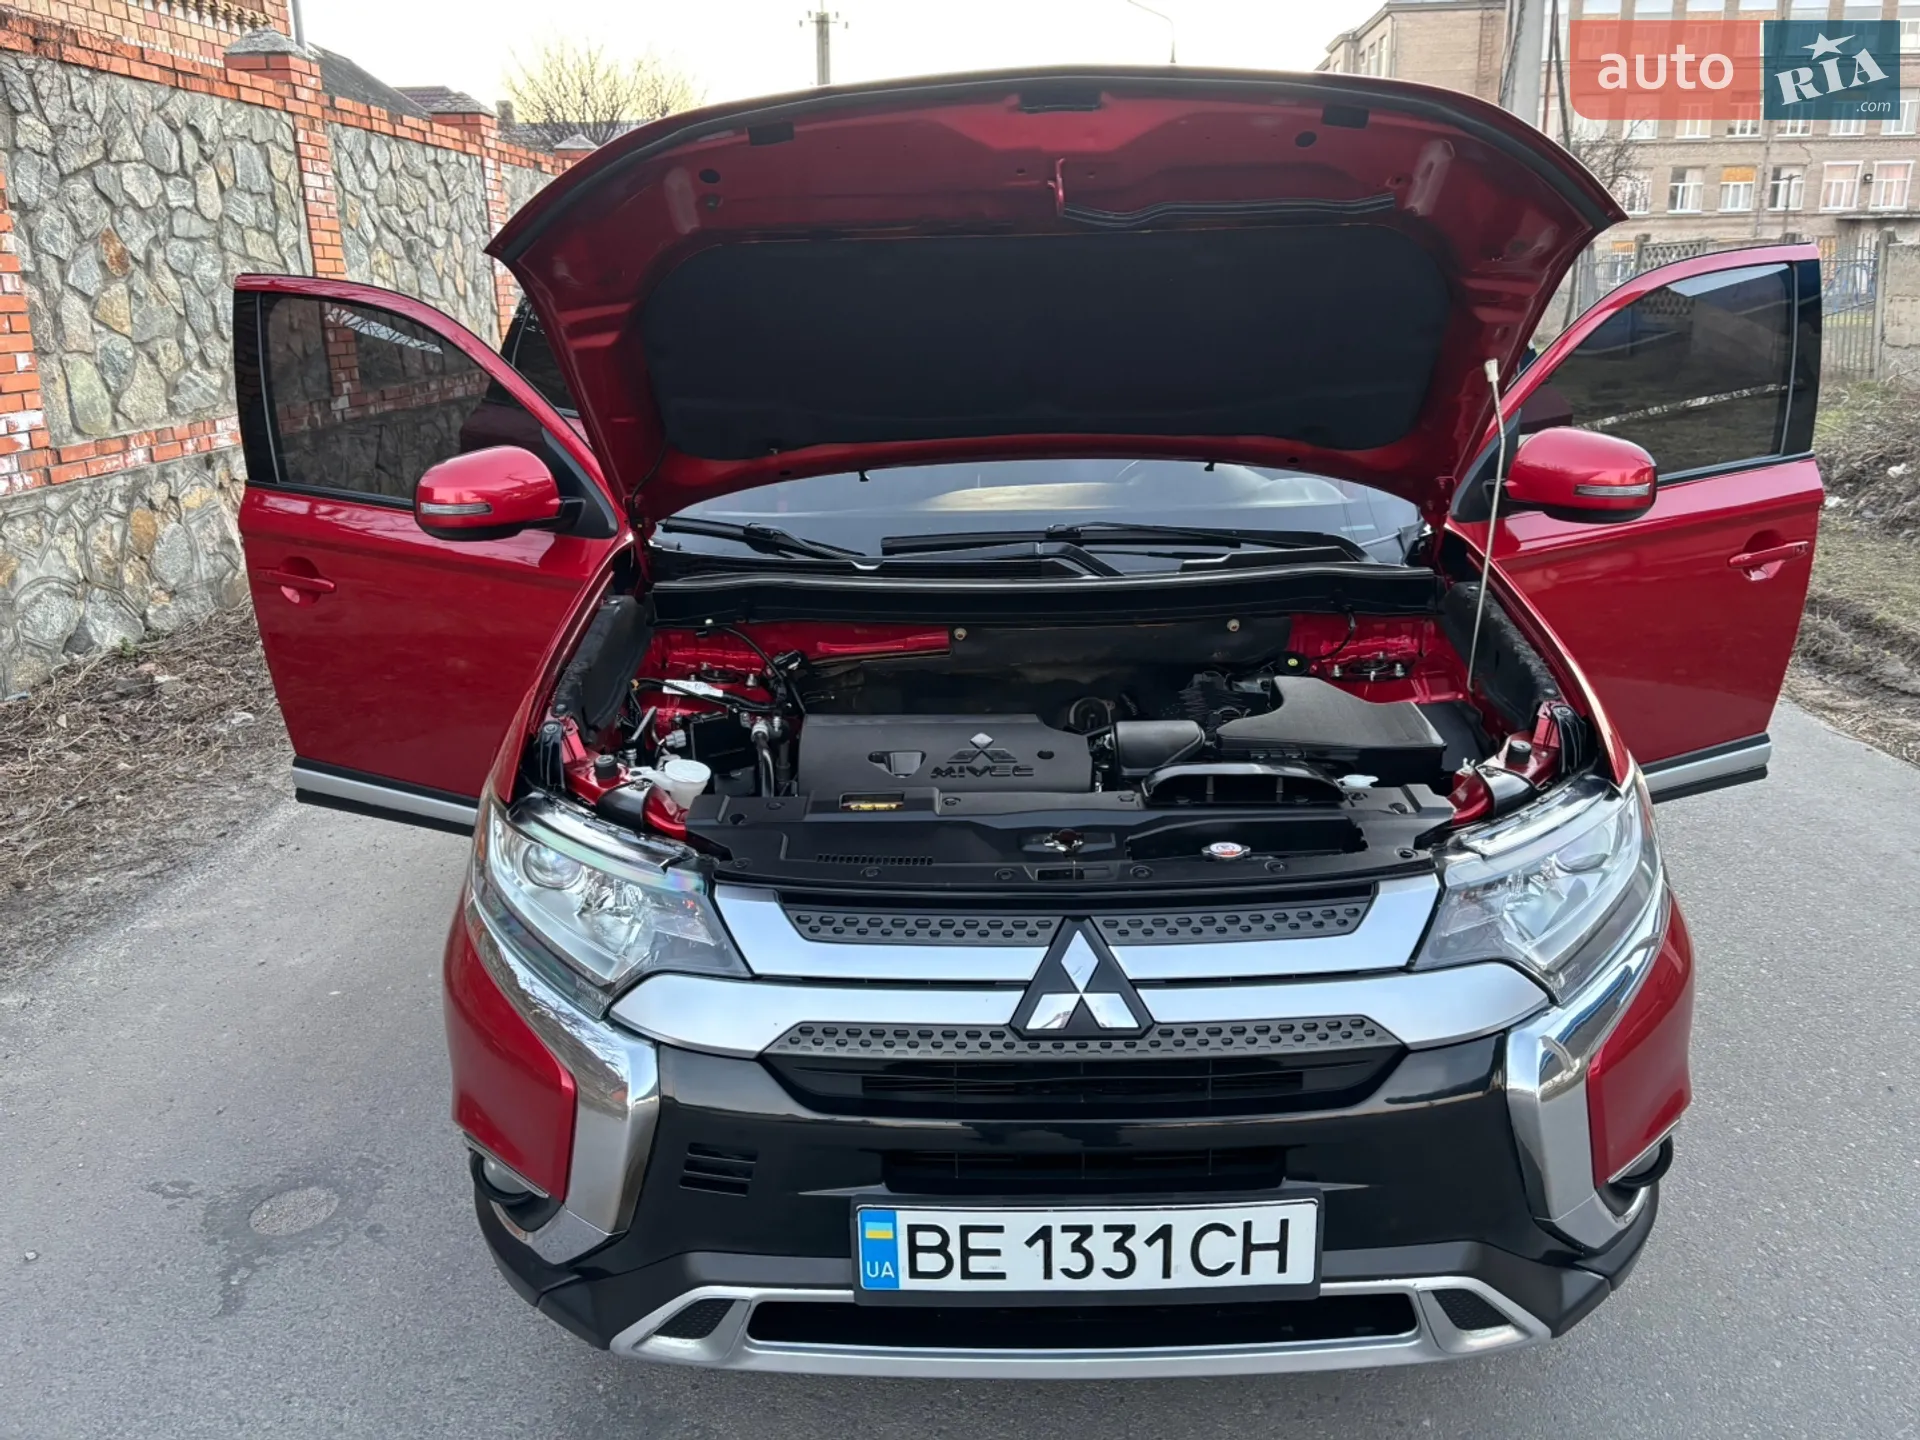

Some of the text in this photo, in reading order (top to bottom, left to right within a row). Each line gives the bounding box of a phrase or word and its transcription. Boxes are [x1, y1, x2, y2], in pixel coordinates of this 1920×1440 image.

[930, 765, 1034, 779] MIVEC
[906, 1217, 1290, 1280] BE 1331 CH
[866, 1260, 895, 1279] UA
